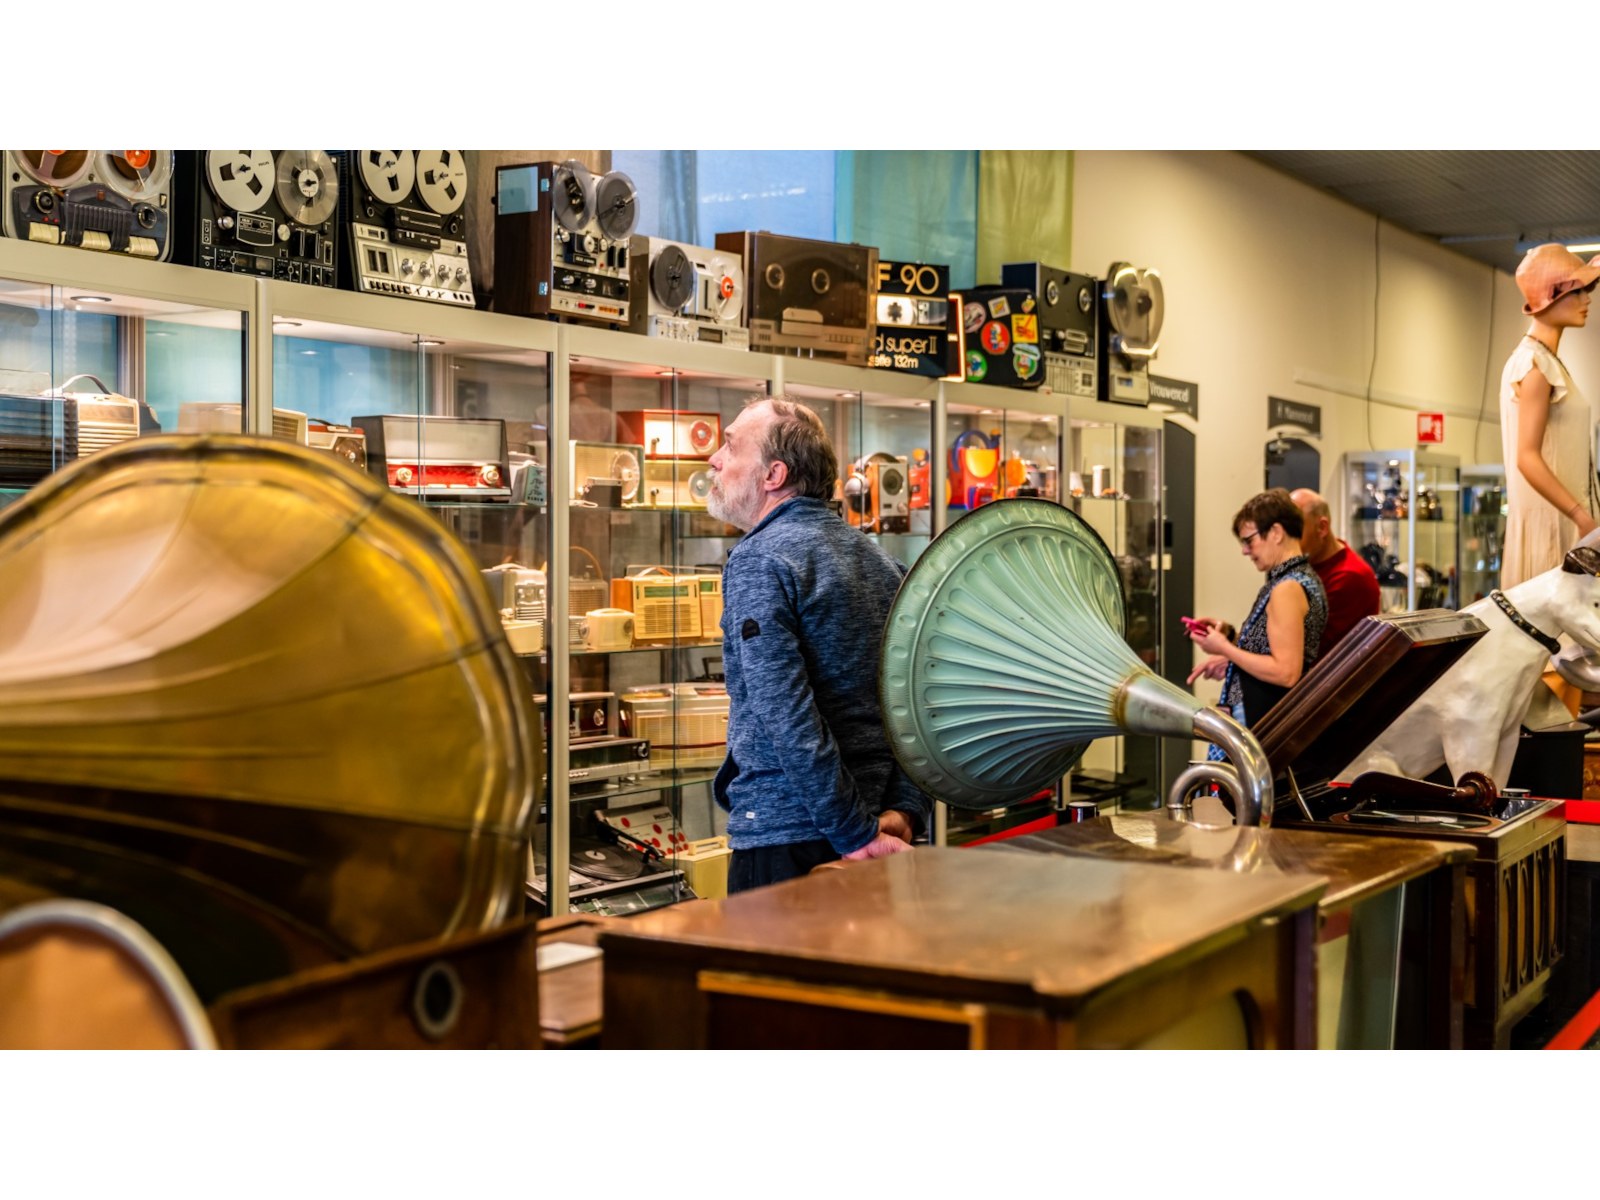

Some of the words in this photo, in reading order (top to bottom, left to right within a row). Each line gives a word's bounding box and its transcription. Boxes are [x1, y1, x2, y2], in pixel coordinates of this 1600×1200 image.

[900, 264, 940, 295] 90
[885, 336, 929, 355] super
[893, 354, 919, 369] 132m
